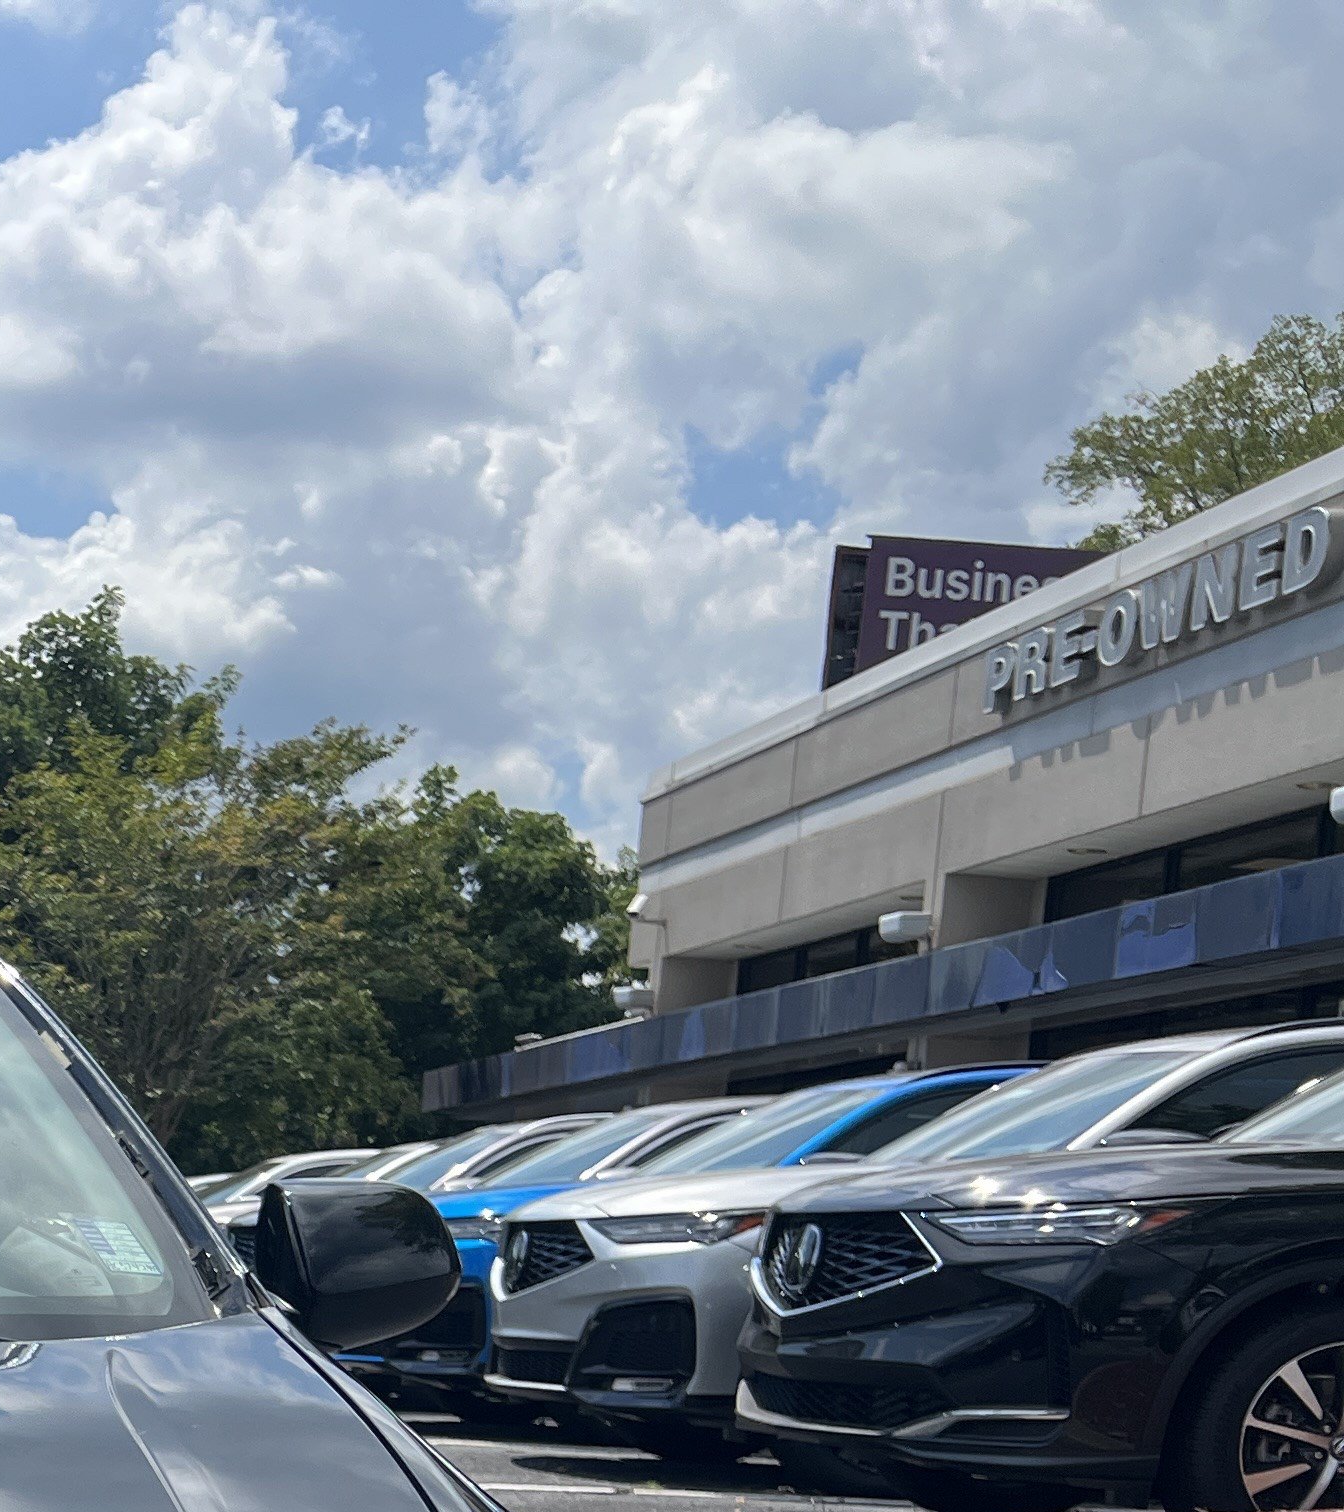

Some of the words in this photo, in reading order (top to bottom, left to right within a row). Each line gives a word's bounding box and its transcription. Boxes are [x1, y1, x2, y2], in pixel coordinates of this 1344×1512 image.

[884, 556, 1062, 603] Busine
[878, 610, 960, 650] Th
[983, 506, 1330, 714] PRE-OWNED
